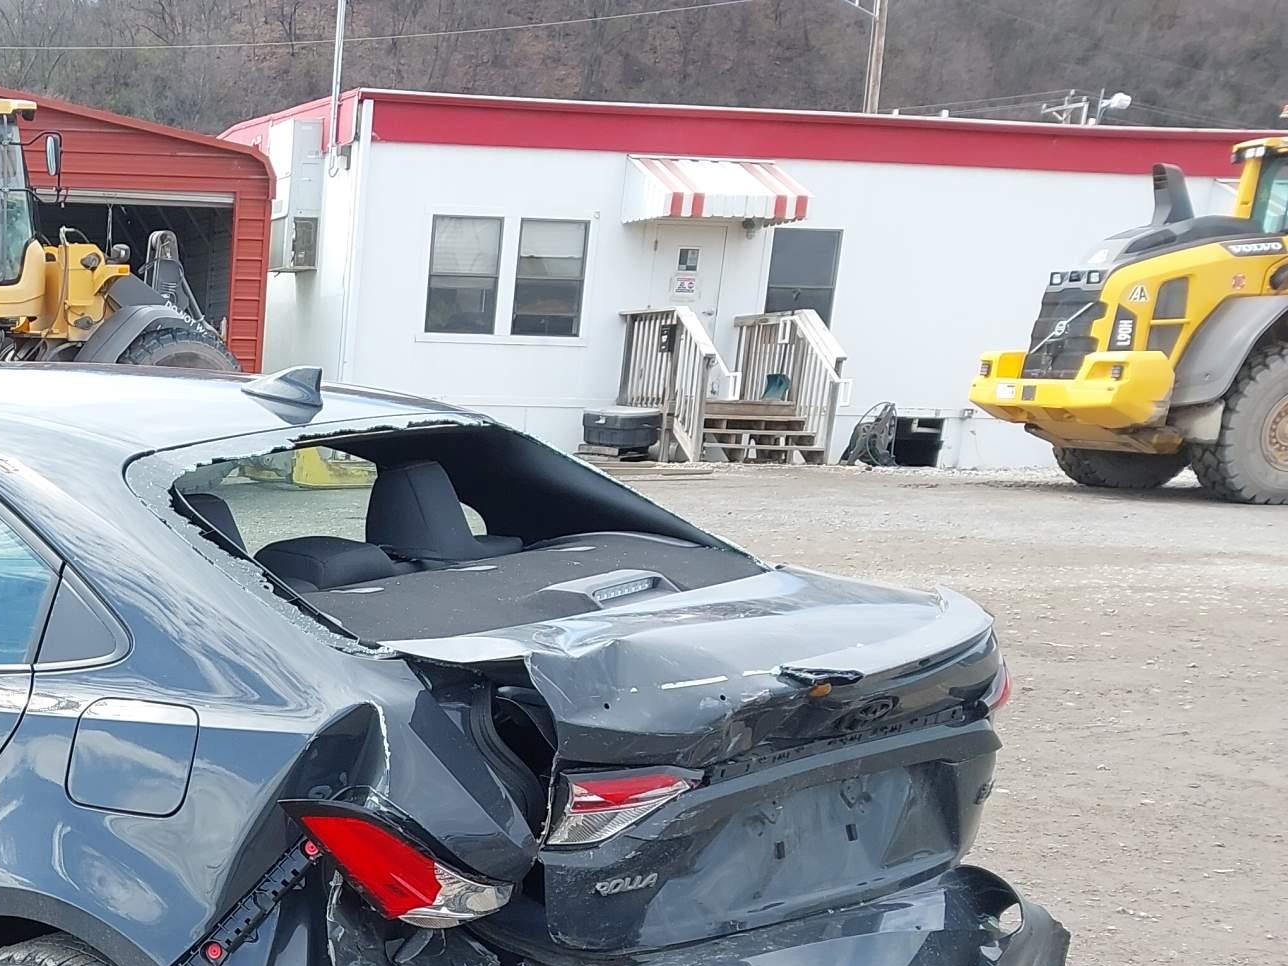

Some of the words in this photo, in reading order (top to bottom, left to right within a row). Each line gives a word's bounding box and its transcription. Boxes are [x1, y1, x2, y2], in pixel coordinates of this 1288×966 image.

[1227, 241, 1283, 254] VOLVO
[176, 310, 197, 327] NOT
[1116, 320, 1133, 345] L90H
